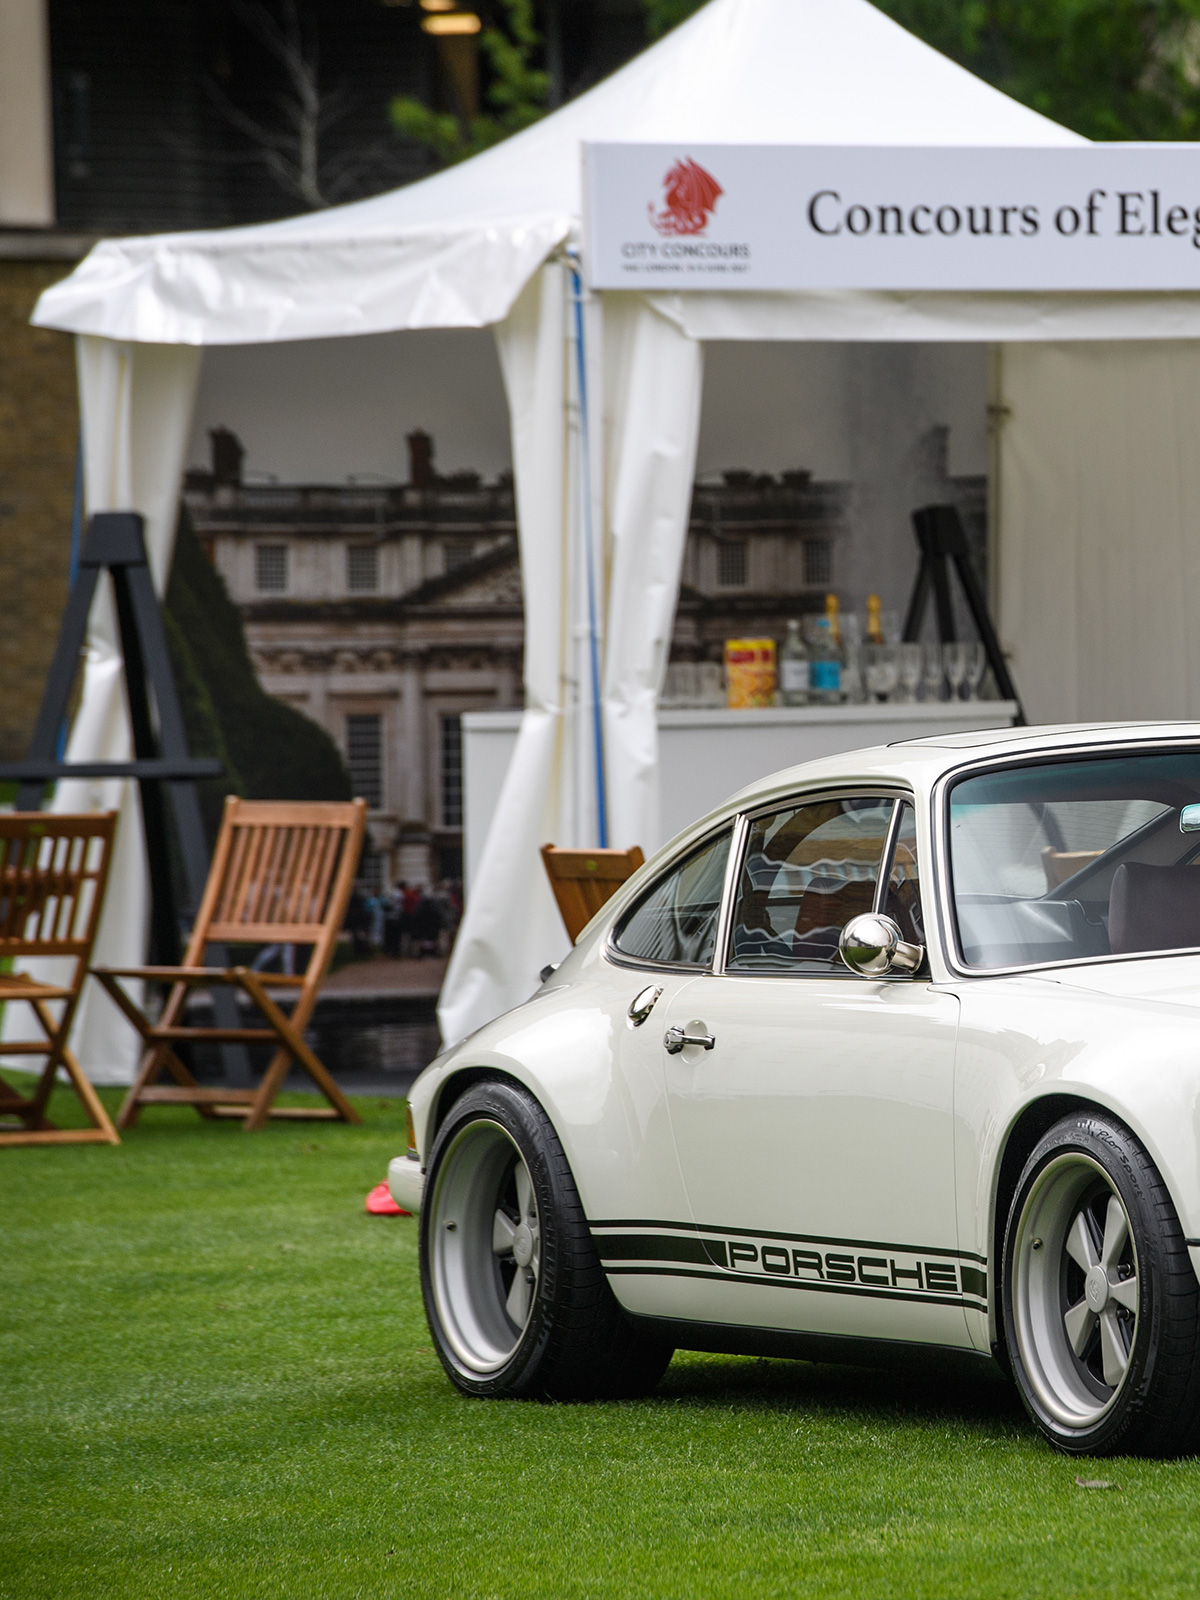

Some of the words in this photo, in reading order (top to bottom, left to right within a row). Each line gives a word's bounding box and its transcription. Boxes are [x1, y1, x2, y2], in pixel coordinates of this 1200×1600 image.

[807, 189, 1040, 237] Concours
[1054, 188, 1107, 237] of
[621, 241, 657, 259] CITY
[660, 241, 751, 259] CONCOURS
[728, 1241, 959, 1292] PORSCHE
